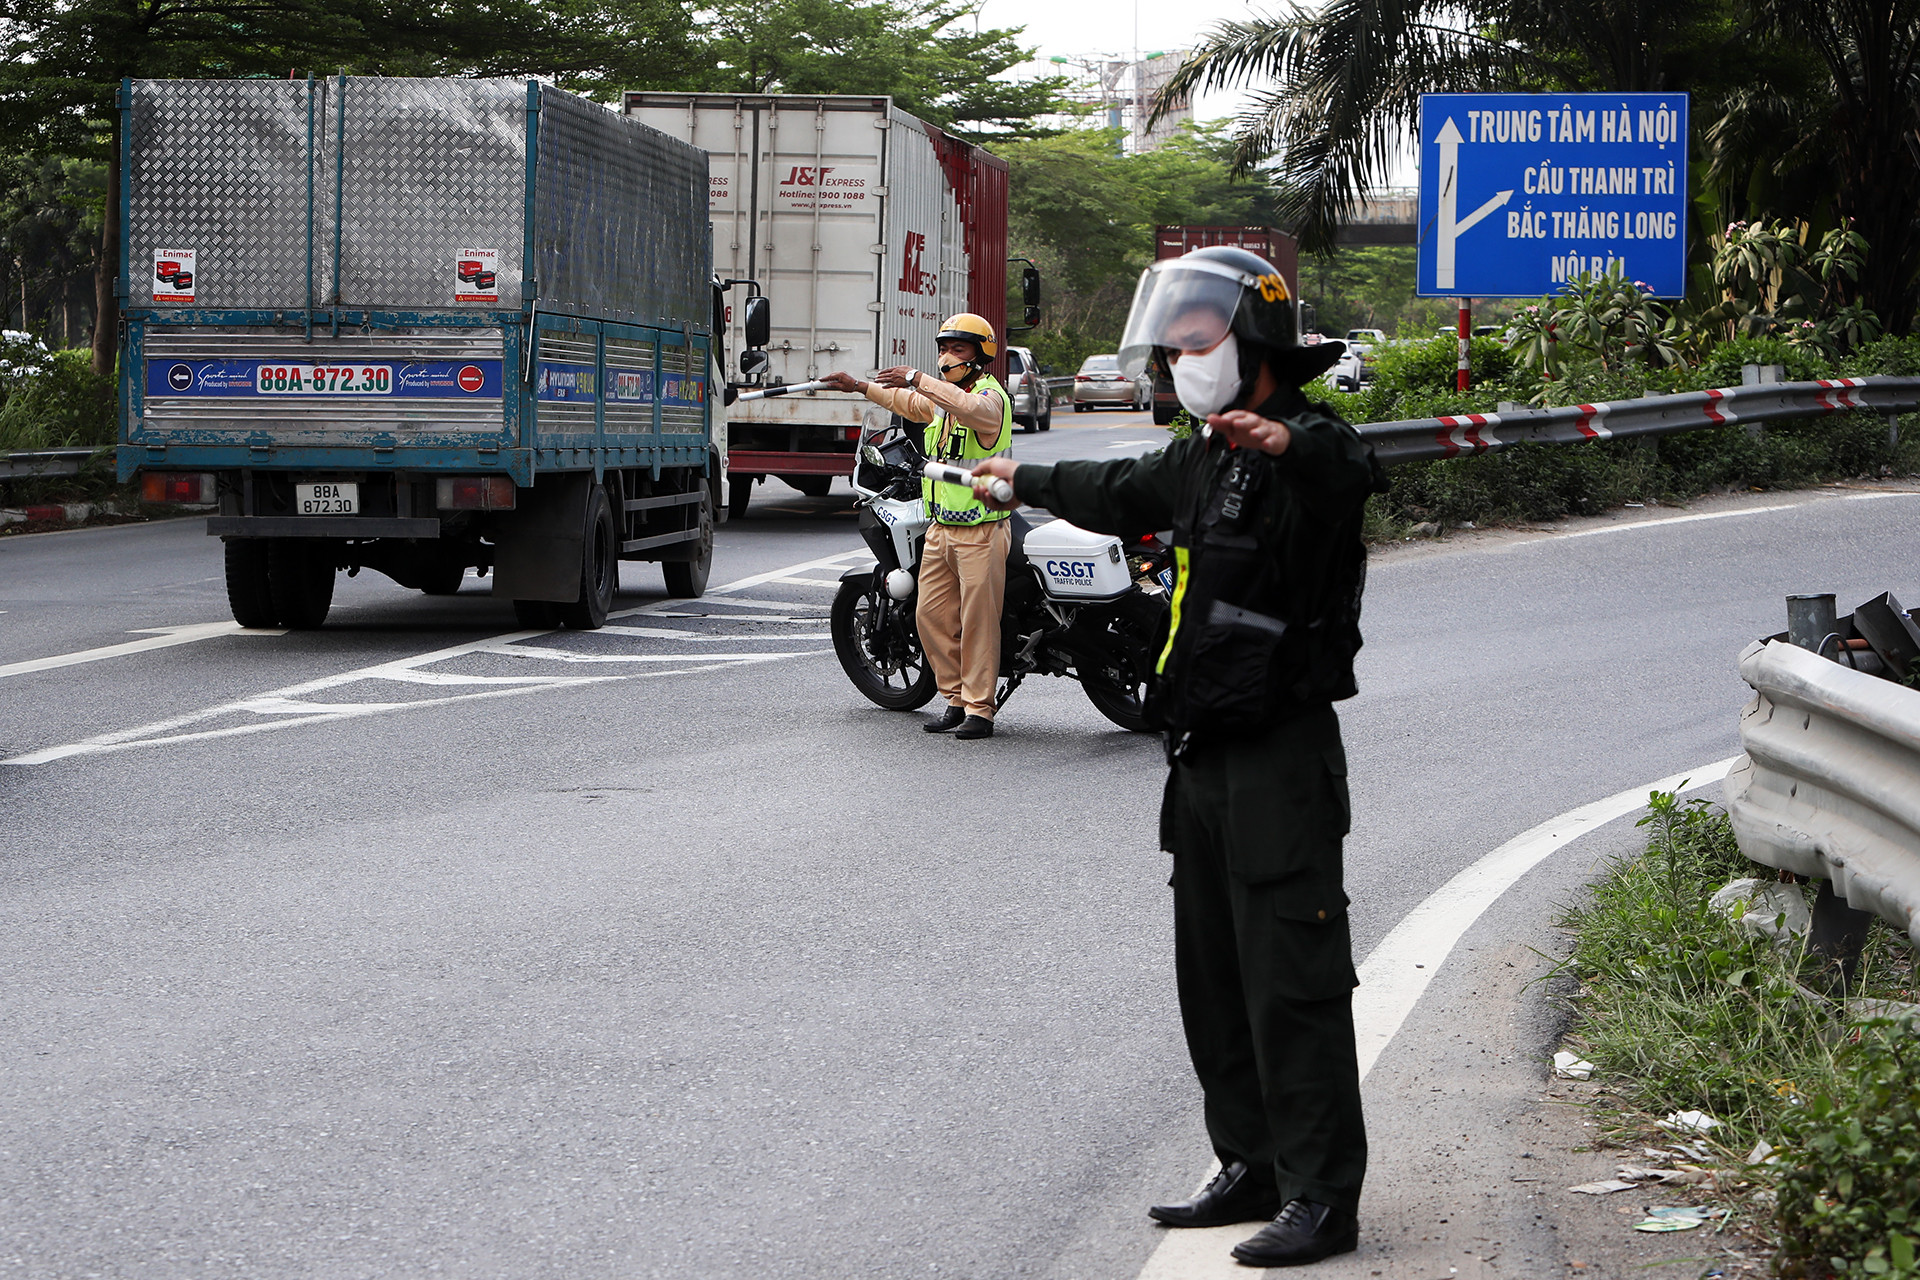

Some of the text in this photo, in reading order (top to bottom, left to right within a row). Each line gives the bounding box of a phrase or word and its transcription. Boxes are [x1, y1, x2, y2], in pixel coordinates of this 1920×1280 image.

[1468, 103, 1677, 149] TRUNG TÂM HÀ NỘI
[780, 167, 865, 187] J&T EXPRESS
[1523, 159, 1675, 195] CẦU THANH TRÌ
[779, 190, 865, 200] Hotline: 1900 1088
[1507, 200, 1676, 239] BẮC THĂNG LONG
[163, 250, 193, 258] Enimac
[260, 367, 389, 391] 88A-872.30
[314, 485, 340, 498] 88A
[304, 500, 352, 513] 872.30
[877, 506, 897, 526] CSGT
[1053, 577, 1093, 587] TRAFFIC POLICE
